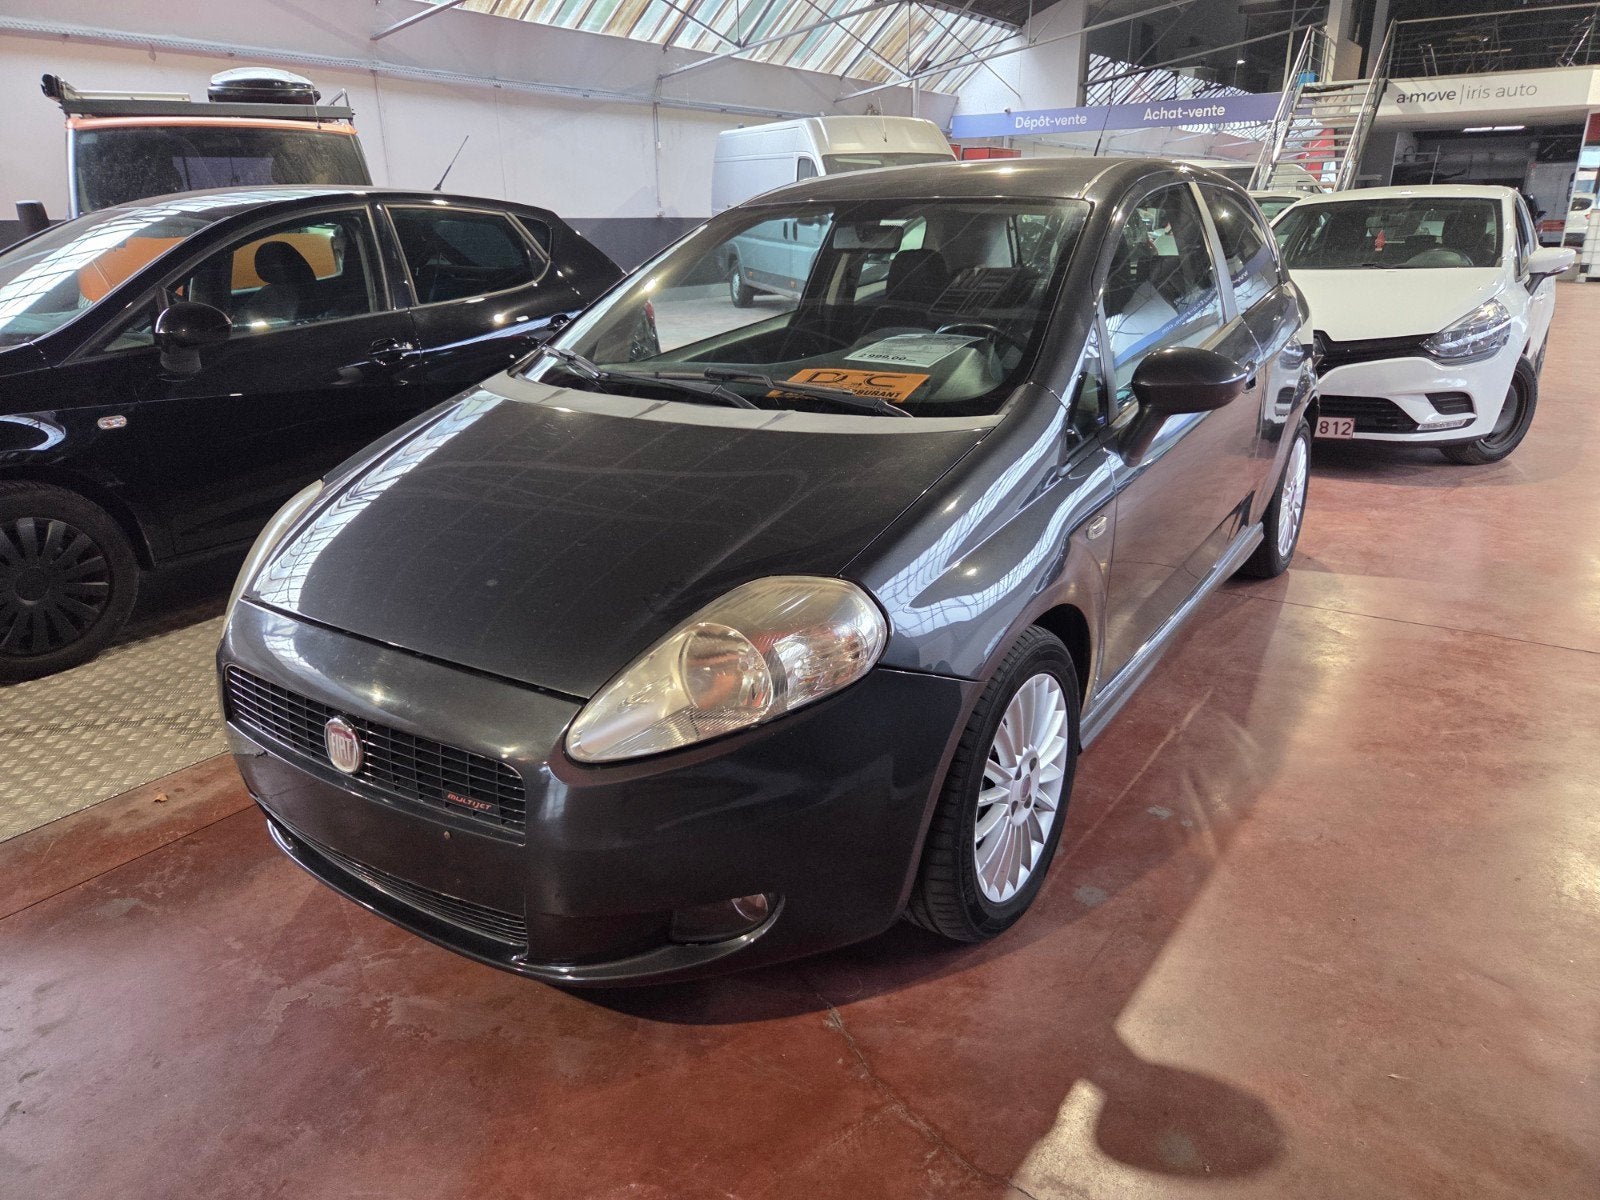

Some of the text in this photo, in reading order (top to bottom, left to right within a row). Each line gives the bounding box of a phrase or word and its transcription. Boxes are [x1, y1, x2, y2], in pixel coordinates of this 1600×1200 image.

[1466, 85, 1491, 101] iris
[1495, 83, 1538, 98] auto
[1143, 104, 1226, 121] Achat-vente
[1015, 114, 1087, 131] Dépôt-vente
[1318, 421, 1352, 436] 812
[330, 731, 352, 762] FIAT
